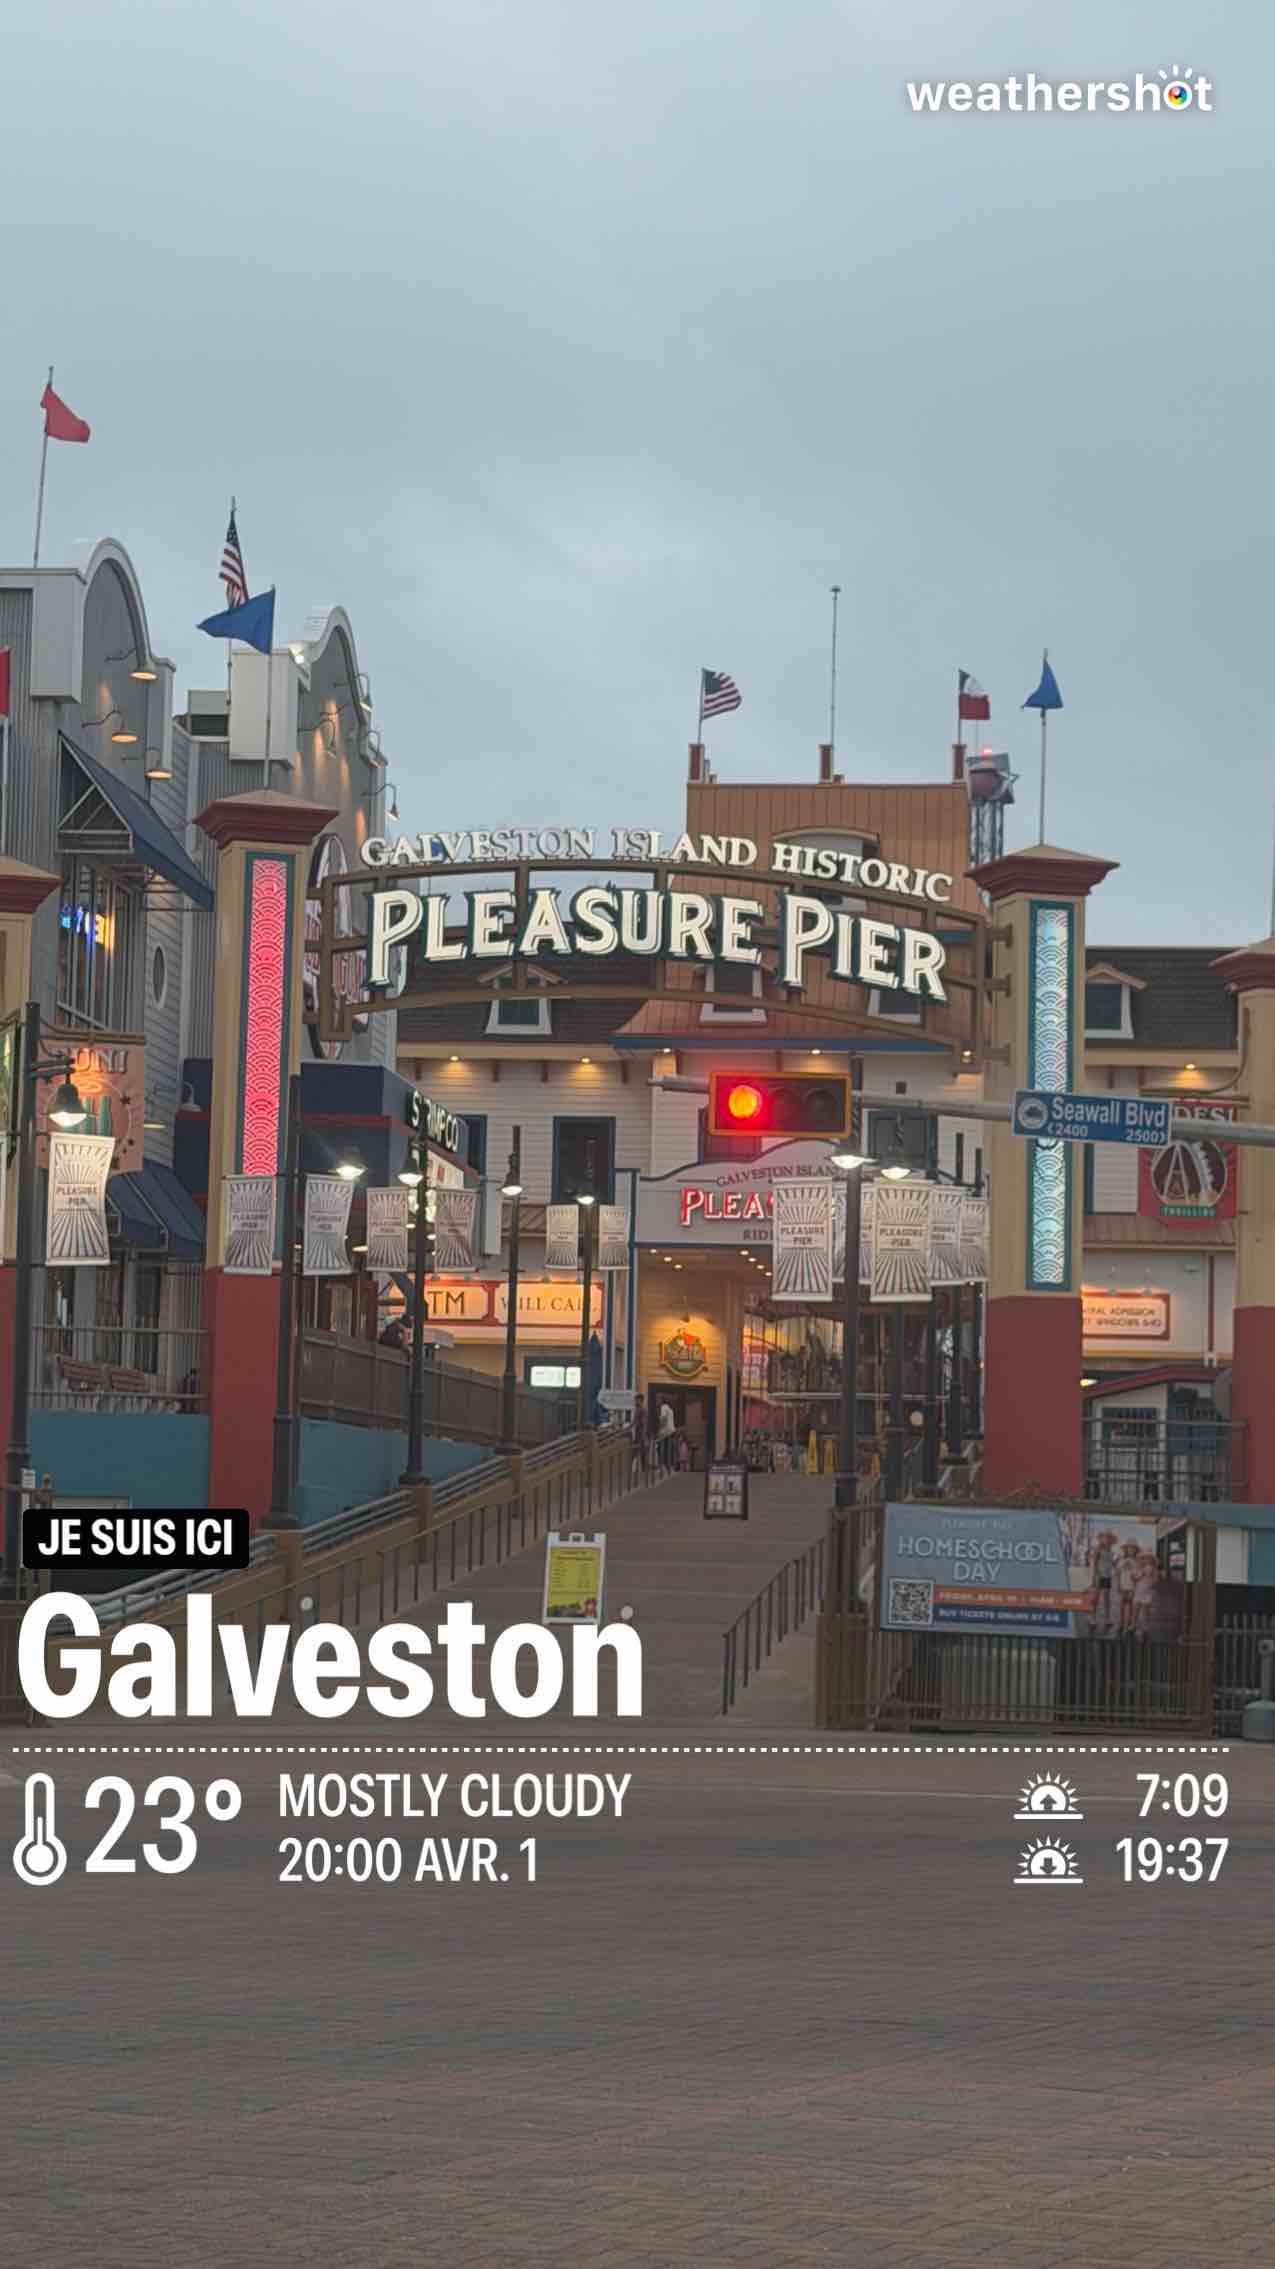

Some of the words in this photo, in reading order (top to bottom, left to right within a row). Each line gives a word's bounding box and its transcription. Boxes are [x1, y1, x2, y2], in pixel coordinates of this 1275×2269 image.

[361, 827, 597, 866] GALVESTON
[611, 827, 757, 866] ISLAND
[771, 842, 952, 902] HISTORIC
[367, 883, 764, 988] PLEASURE
[782, 892, 949, 1001] PIER
[1052, 1096, 1121, 1126] Seawall
[1125, 1102, 1167, 1128] Blvd
[1056, 1124, 1089, 1138] 2400
[1126, 1128, 1160, 1142] 2500
[716, 1165, 793, 1187] GALVESTON
[780, 1226, 825, 1235] PLEASURE
[880, 1228, 923, 1237] PLEASURE
[793, 1237, 813, 1245] PIER
[898, 1536, 1058, 1563] HOMESCHOOL
[952, 1562, 1001, 1582] DAY
